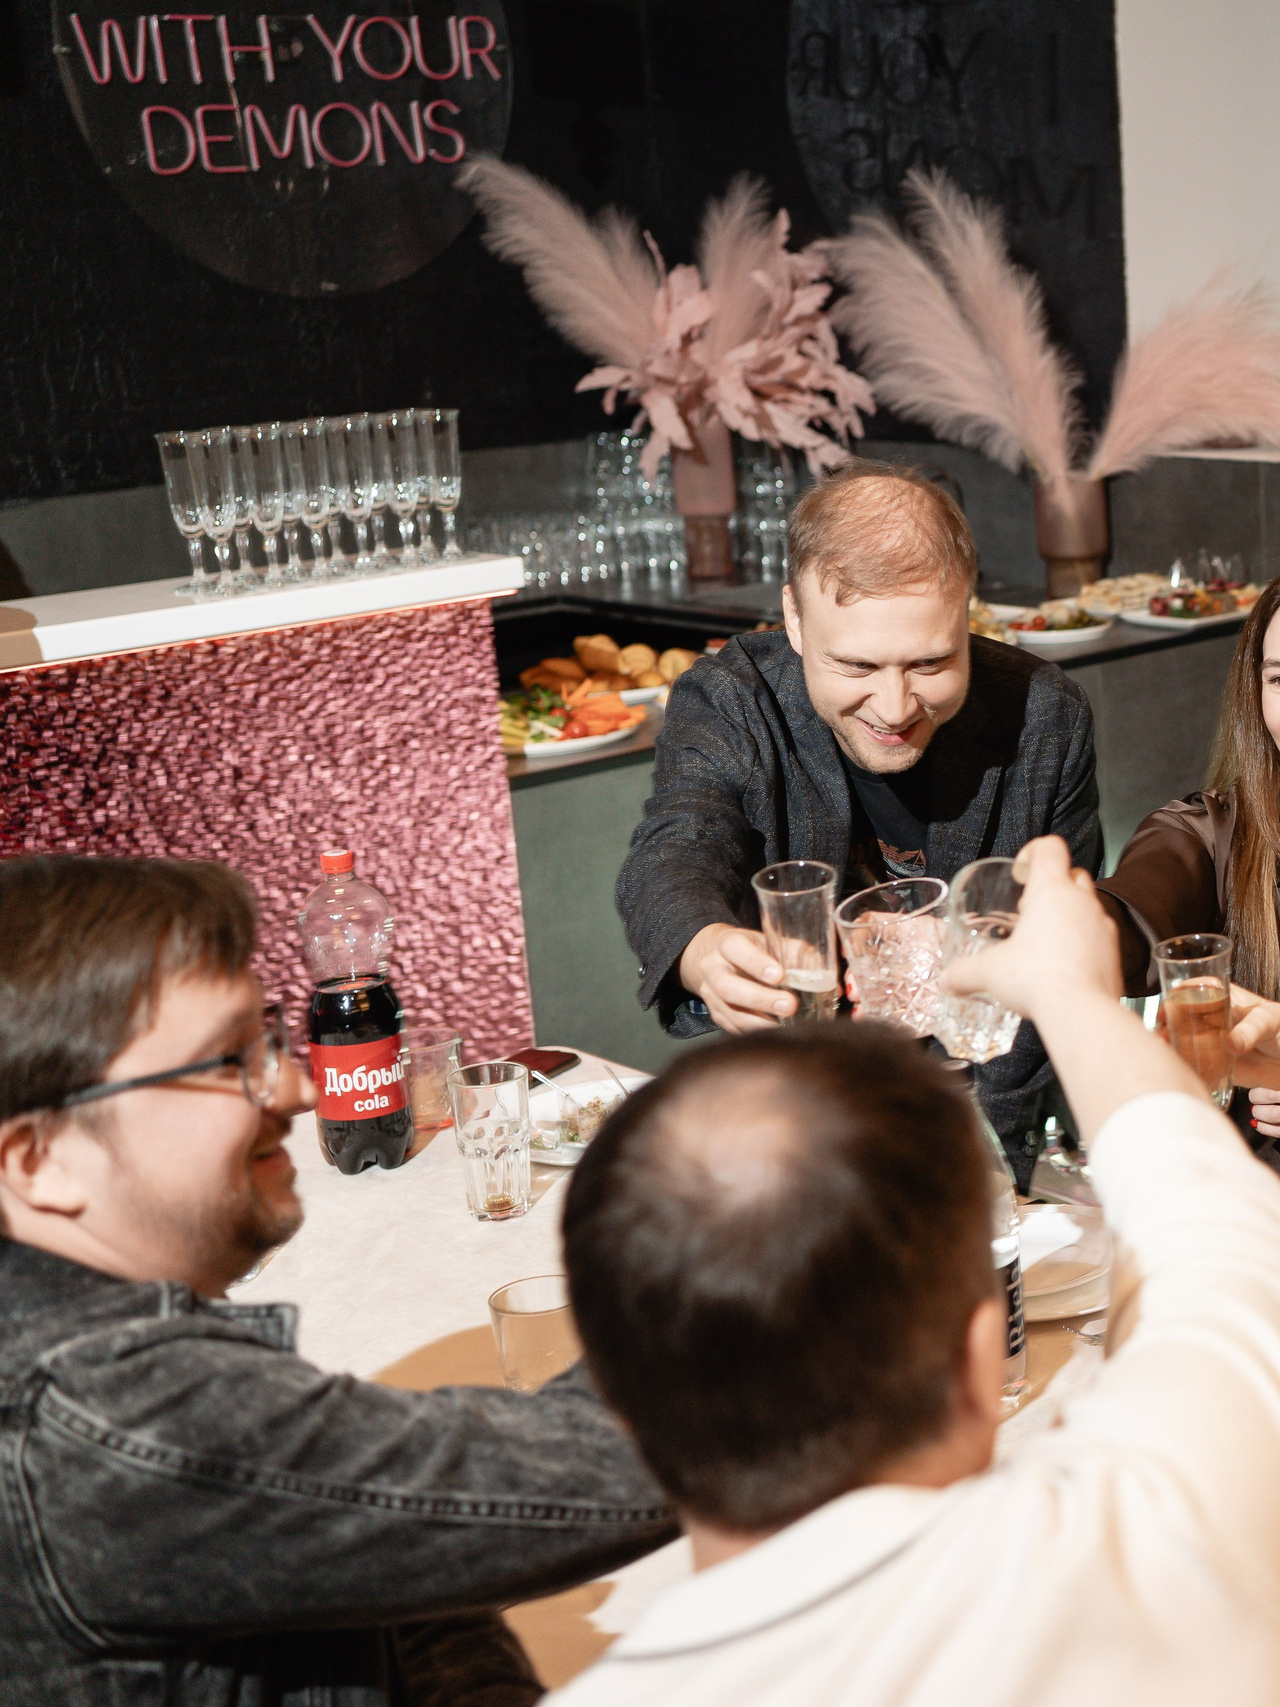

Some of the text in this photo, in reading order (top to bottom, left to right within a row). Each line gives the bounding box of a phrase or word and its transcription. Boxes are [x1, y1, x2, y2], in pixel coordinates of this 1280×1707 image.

[71, 13, 501, 85] WITH YOUR
[141, 100, 466, 176] DEMONS
[324, 1055, 406, 1097] Добрый
[353, 1094, 390, 1113] cola
